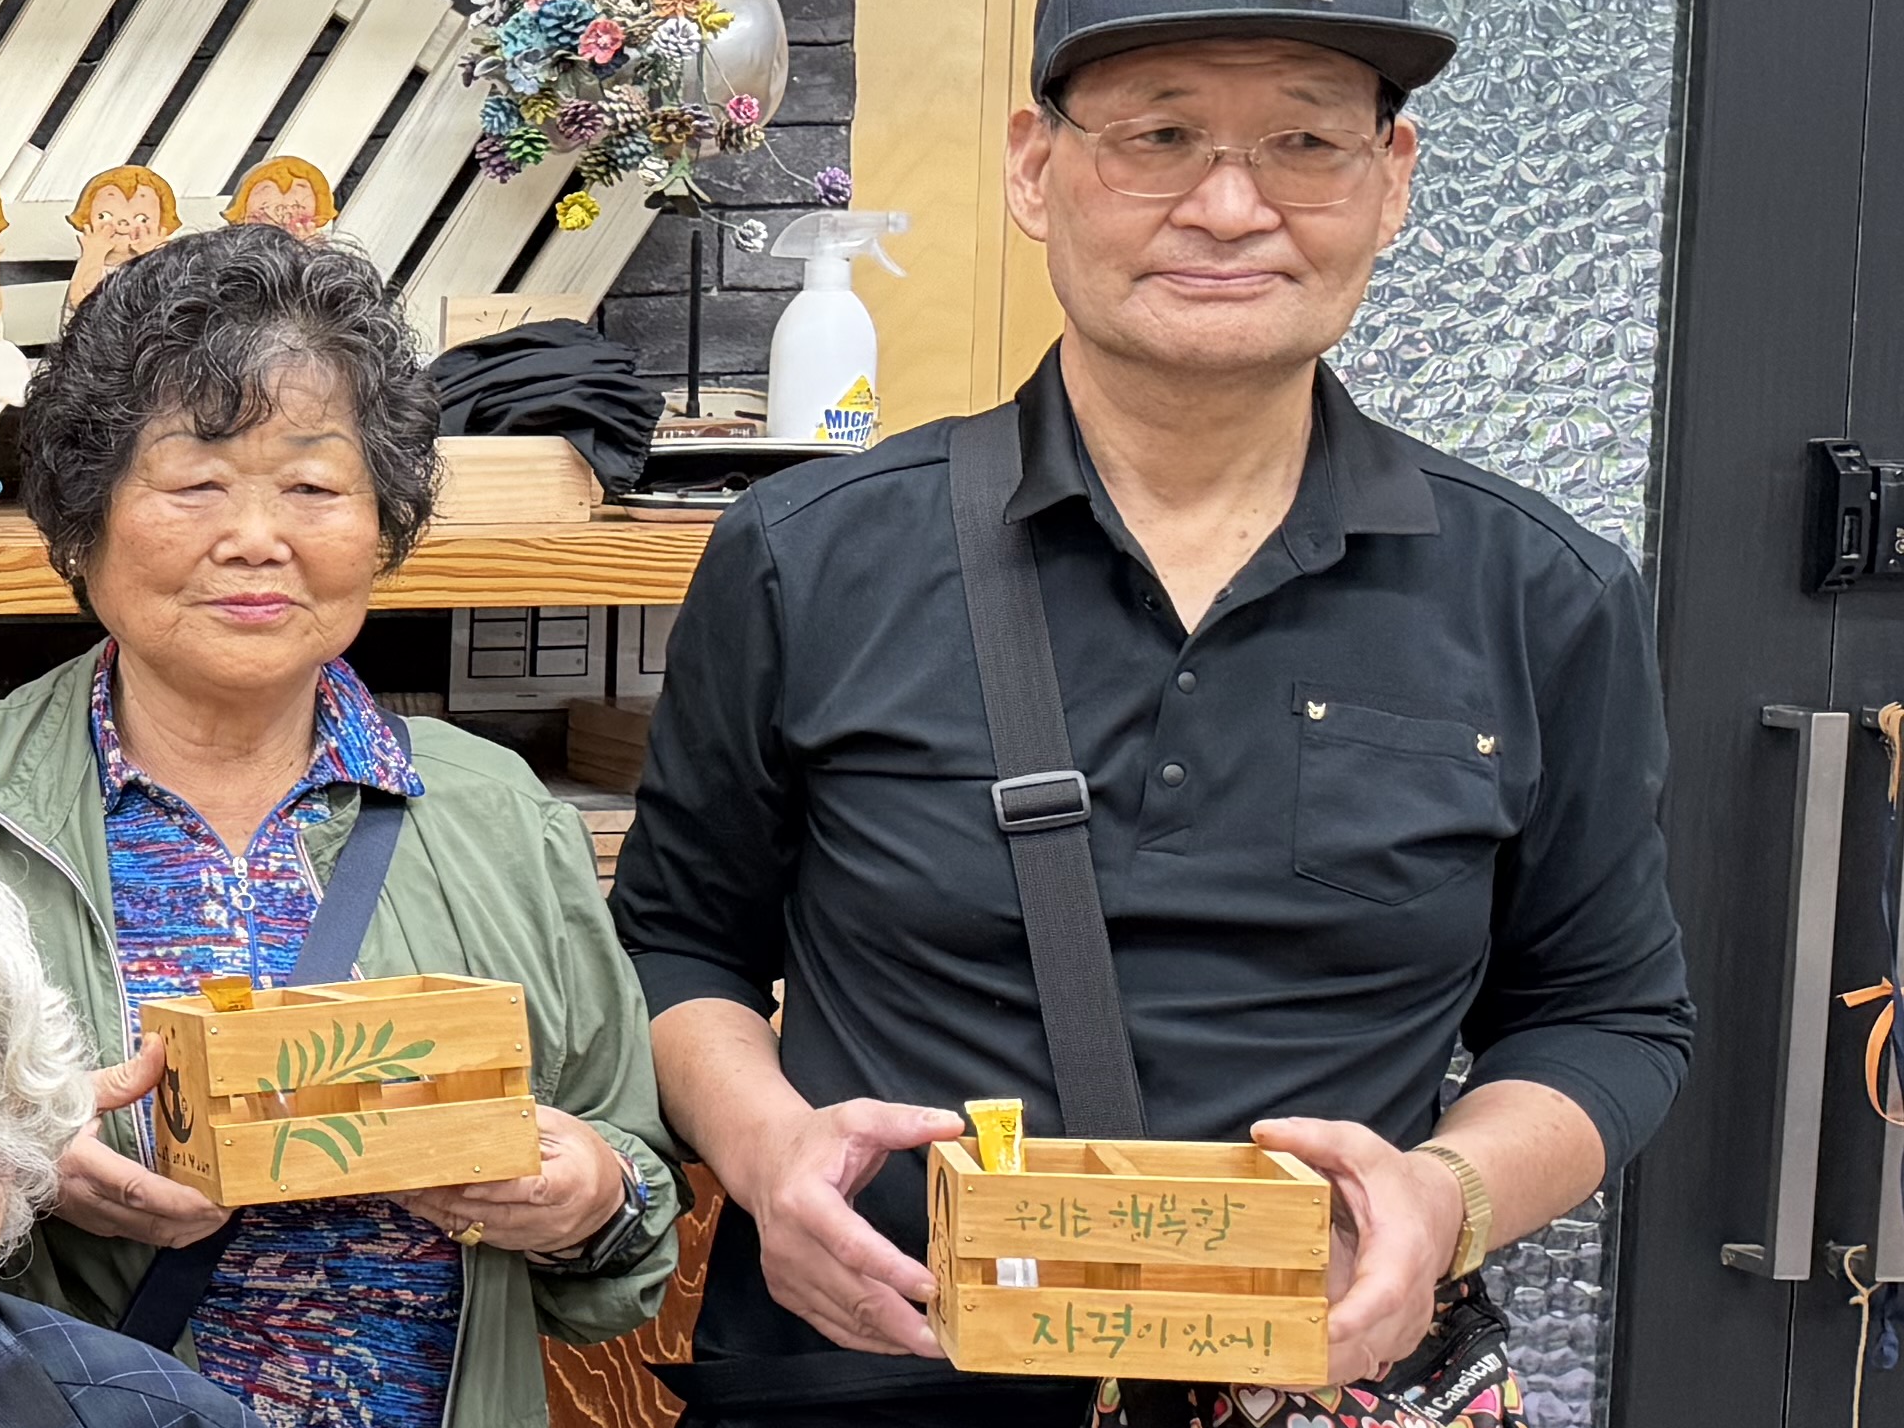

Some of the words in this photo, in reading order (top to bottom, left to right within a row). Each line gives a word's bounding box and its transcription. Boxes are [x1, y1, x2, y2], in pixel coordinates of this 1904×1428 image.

[1003, 1196, 1093, 1238] 우리는
[1107, 1193, 1247, 1252] 행복할
[1030, 1301, 1168, 1360] 자격이
[1182, 1314, 1274, 1358] 있어!
[1431, 1352, 1503, 1411] Capsicum
